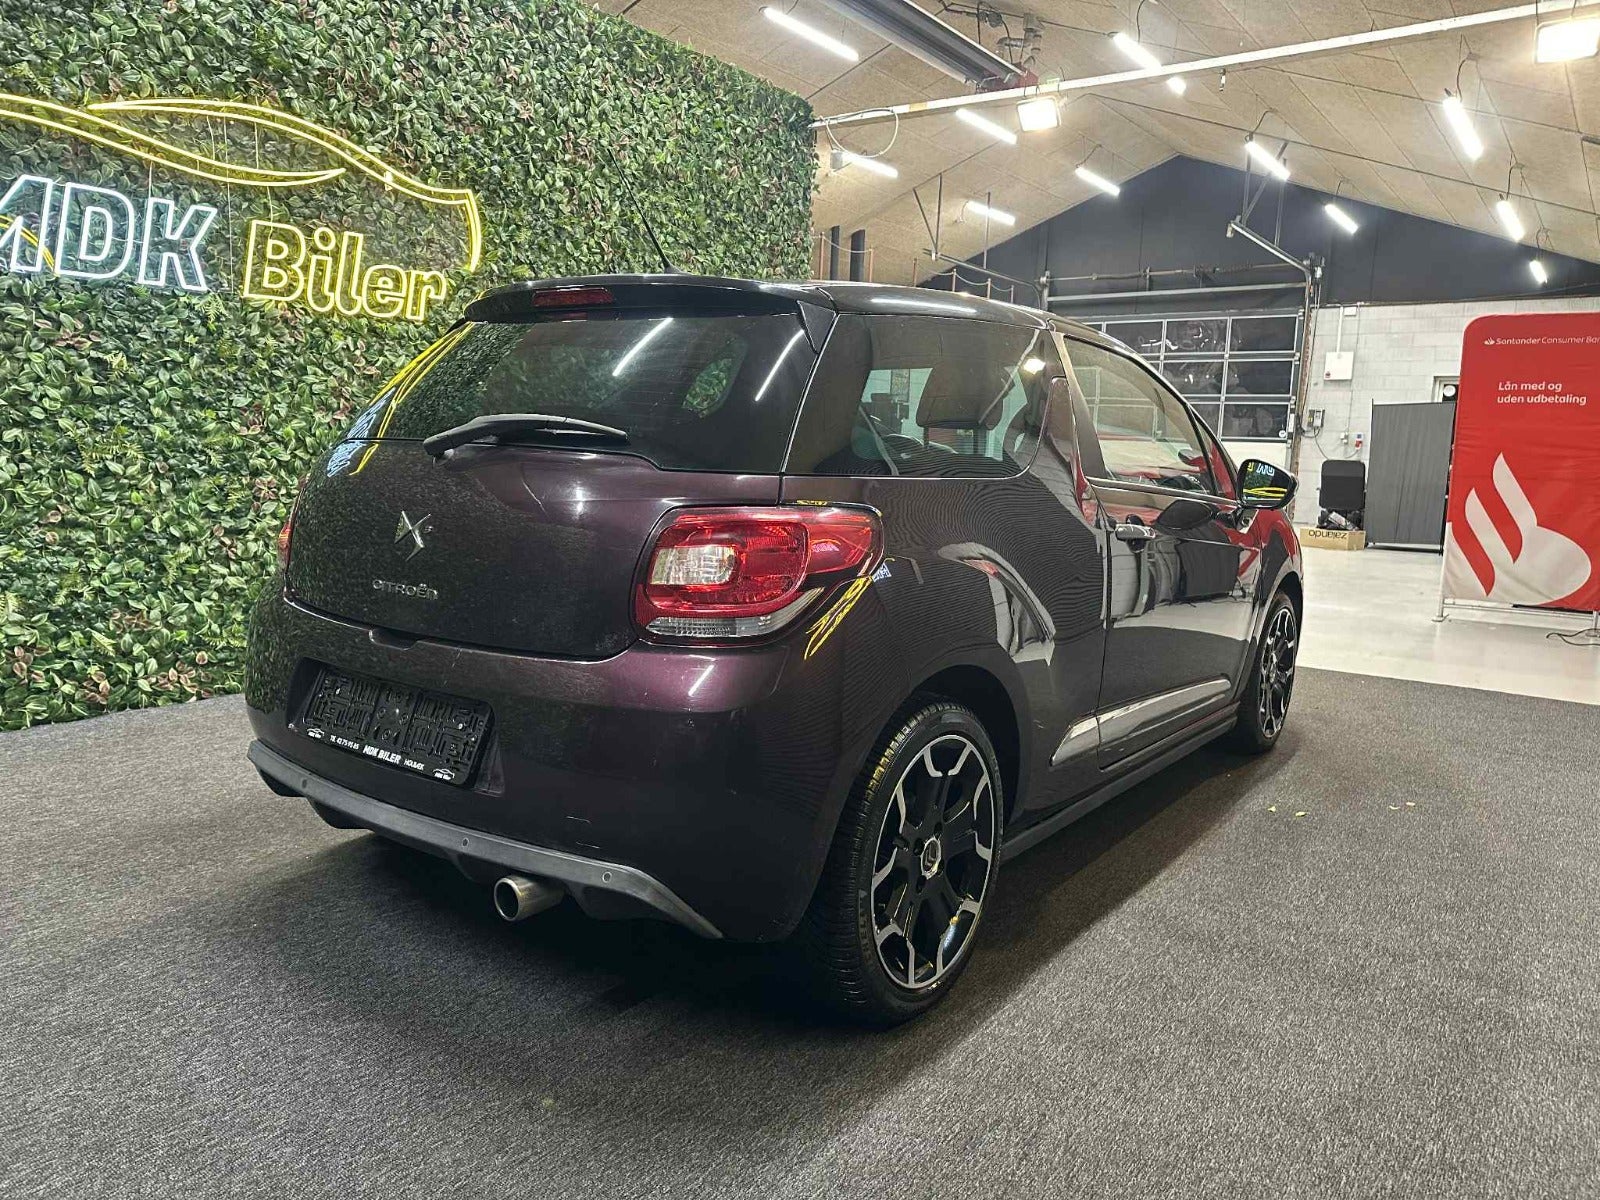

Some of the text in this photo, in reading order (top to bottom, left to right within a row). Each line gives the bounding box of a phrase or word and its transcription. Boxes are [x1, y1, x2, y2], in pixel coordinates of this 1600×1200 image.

[243, 219, 447, 321] Biler
[1495, 337, 1540, 345] Santander
[1541, 336, 1583, 344] Consumer
[1498, 381, 1562, 392] Lån med og
[1497, 394, 1587, 406] uden udbetaling
[1308, 530, 1347, 540] zalando
[378, 749, 401, 764] BILER
